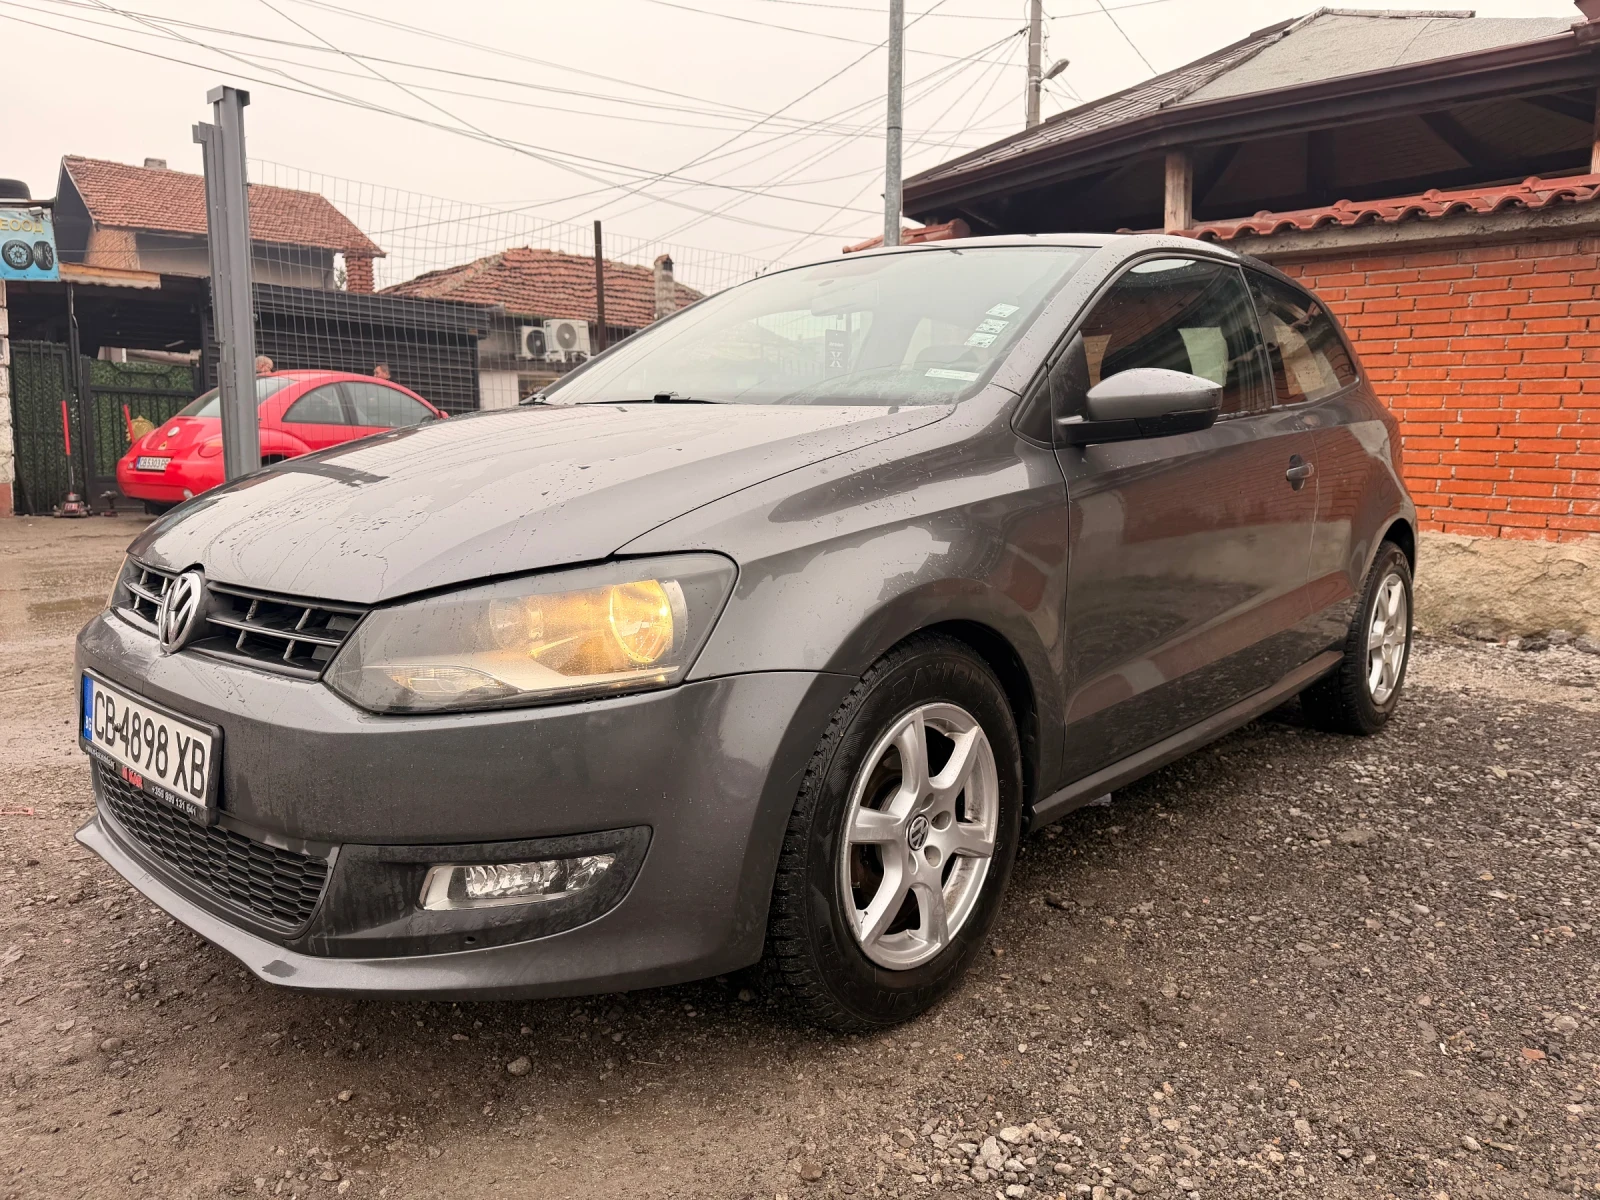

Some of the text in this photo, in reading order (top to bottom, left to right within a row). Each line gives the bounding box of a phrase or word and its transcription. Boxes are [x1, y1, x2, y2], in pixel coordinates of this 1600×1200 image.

[85, 714, 93, 732] BG
[94, 690, 206, 799] CB 4898 XB
